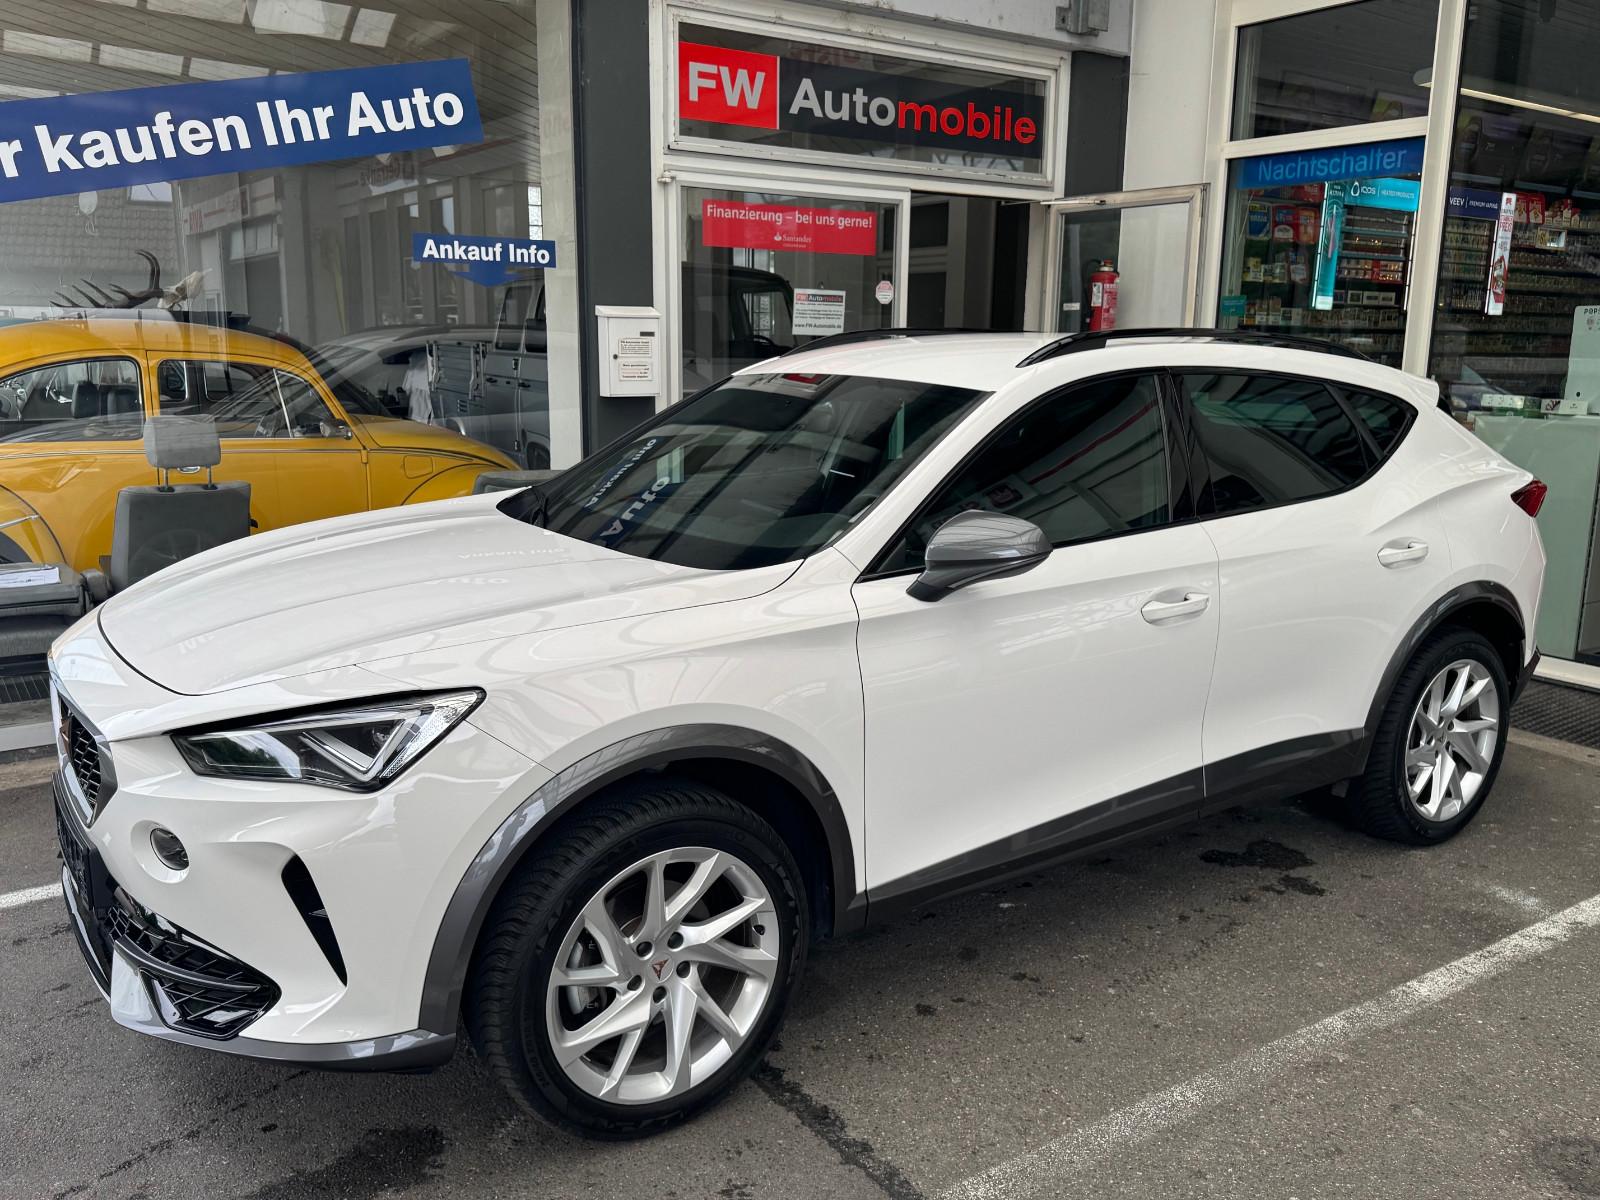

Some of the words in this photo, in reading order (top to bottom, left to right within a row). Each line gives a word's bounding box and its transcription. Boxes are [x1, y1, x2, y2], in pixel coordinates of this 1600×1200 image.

[688, 61, 765, 109] FW
[789, 77, 1037, 144] Automobile
[35, 111, 251, 172] kaufen
[256, 99, 334, 146] Ihr
[347, 87, 464, 137] Auto
[1258, 148, 1407, 182] Nachtschalter
[707, 204, 782, 226] Finanzierung
[795, 211, 812, 224] bei
[816, 214, 835, 226] uns
[837, 217, 873, 230] gerne!
[422, 239, 502, 261] Ankauf
[509, 243, 550, 264] Info
[783, 233, 811, 243] Santander
